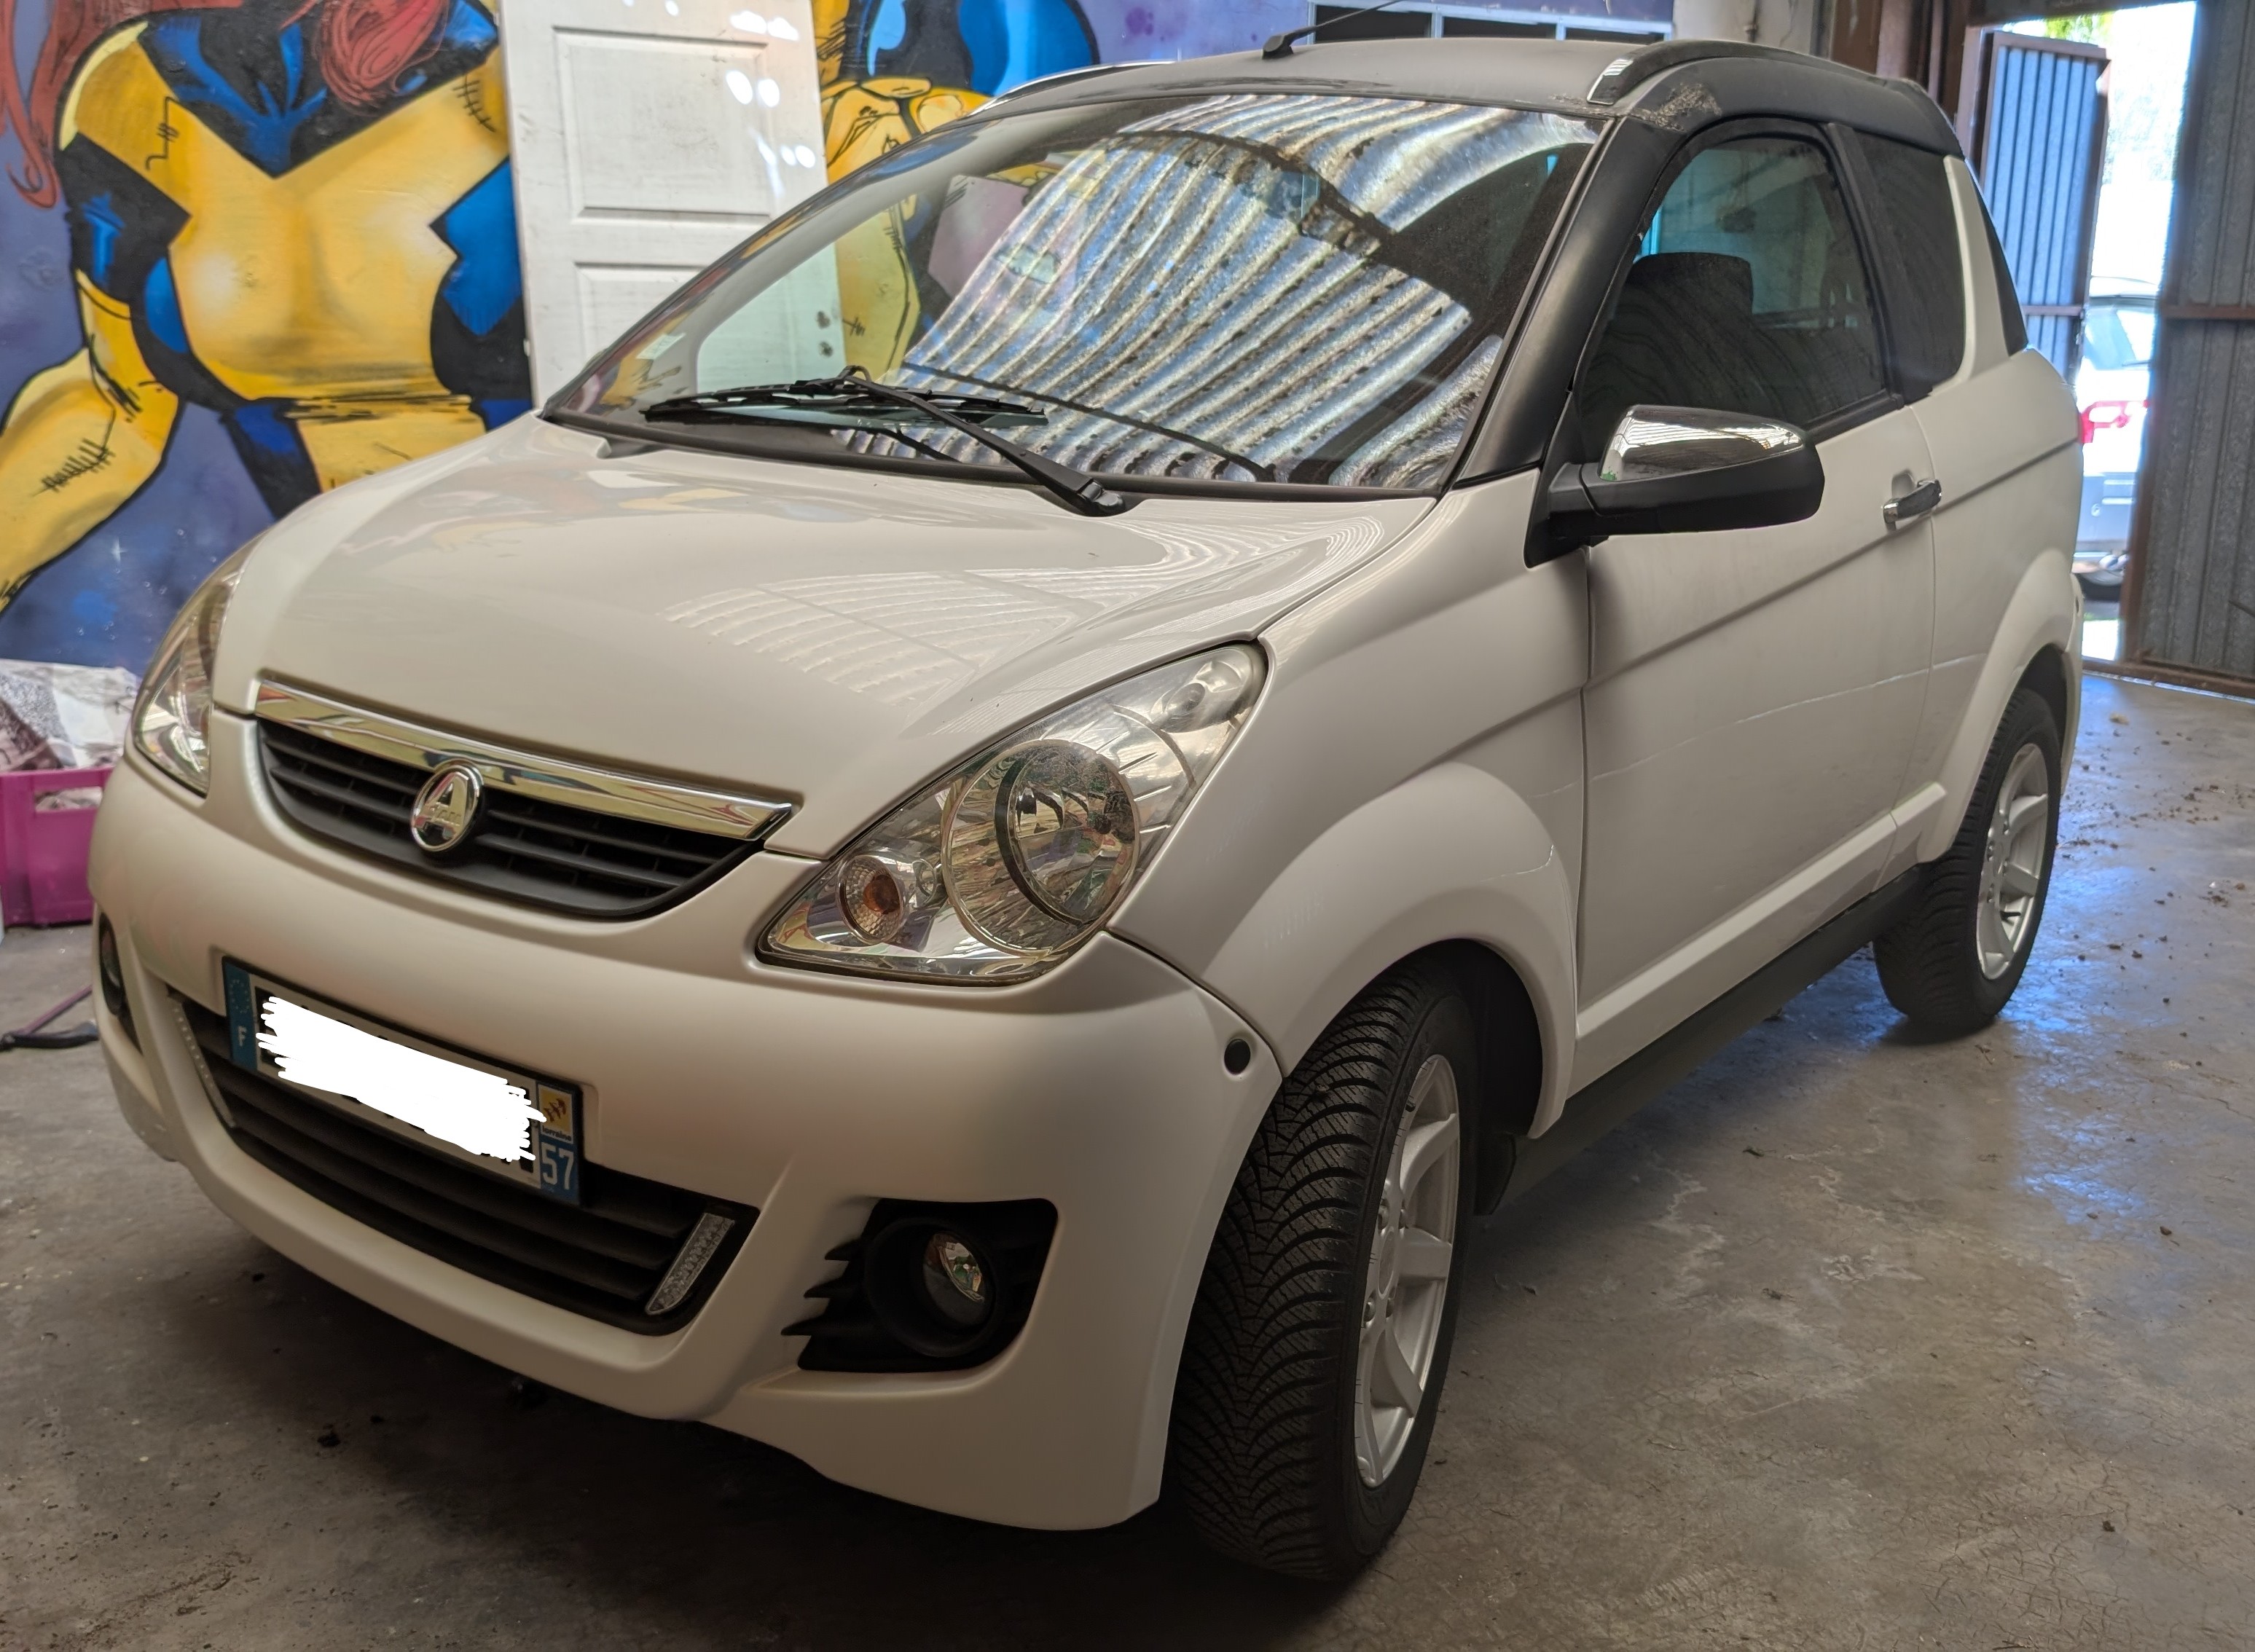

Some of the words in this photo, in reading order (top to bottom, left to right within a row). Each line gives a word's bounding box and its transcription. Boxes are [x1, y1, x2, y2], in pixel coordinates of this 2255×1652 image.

[238, 1025, 248, 1047] F
[541, 1125, 572, 1141] lorraine
[541, 1141, 574, 1190] 57
